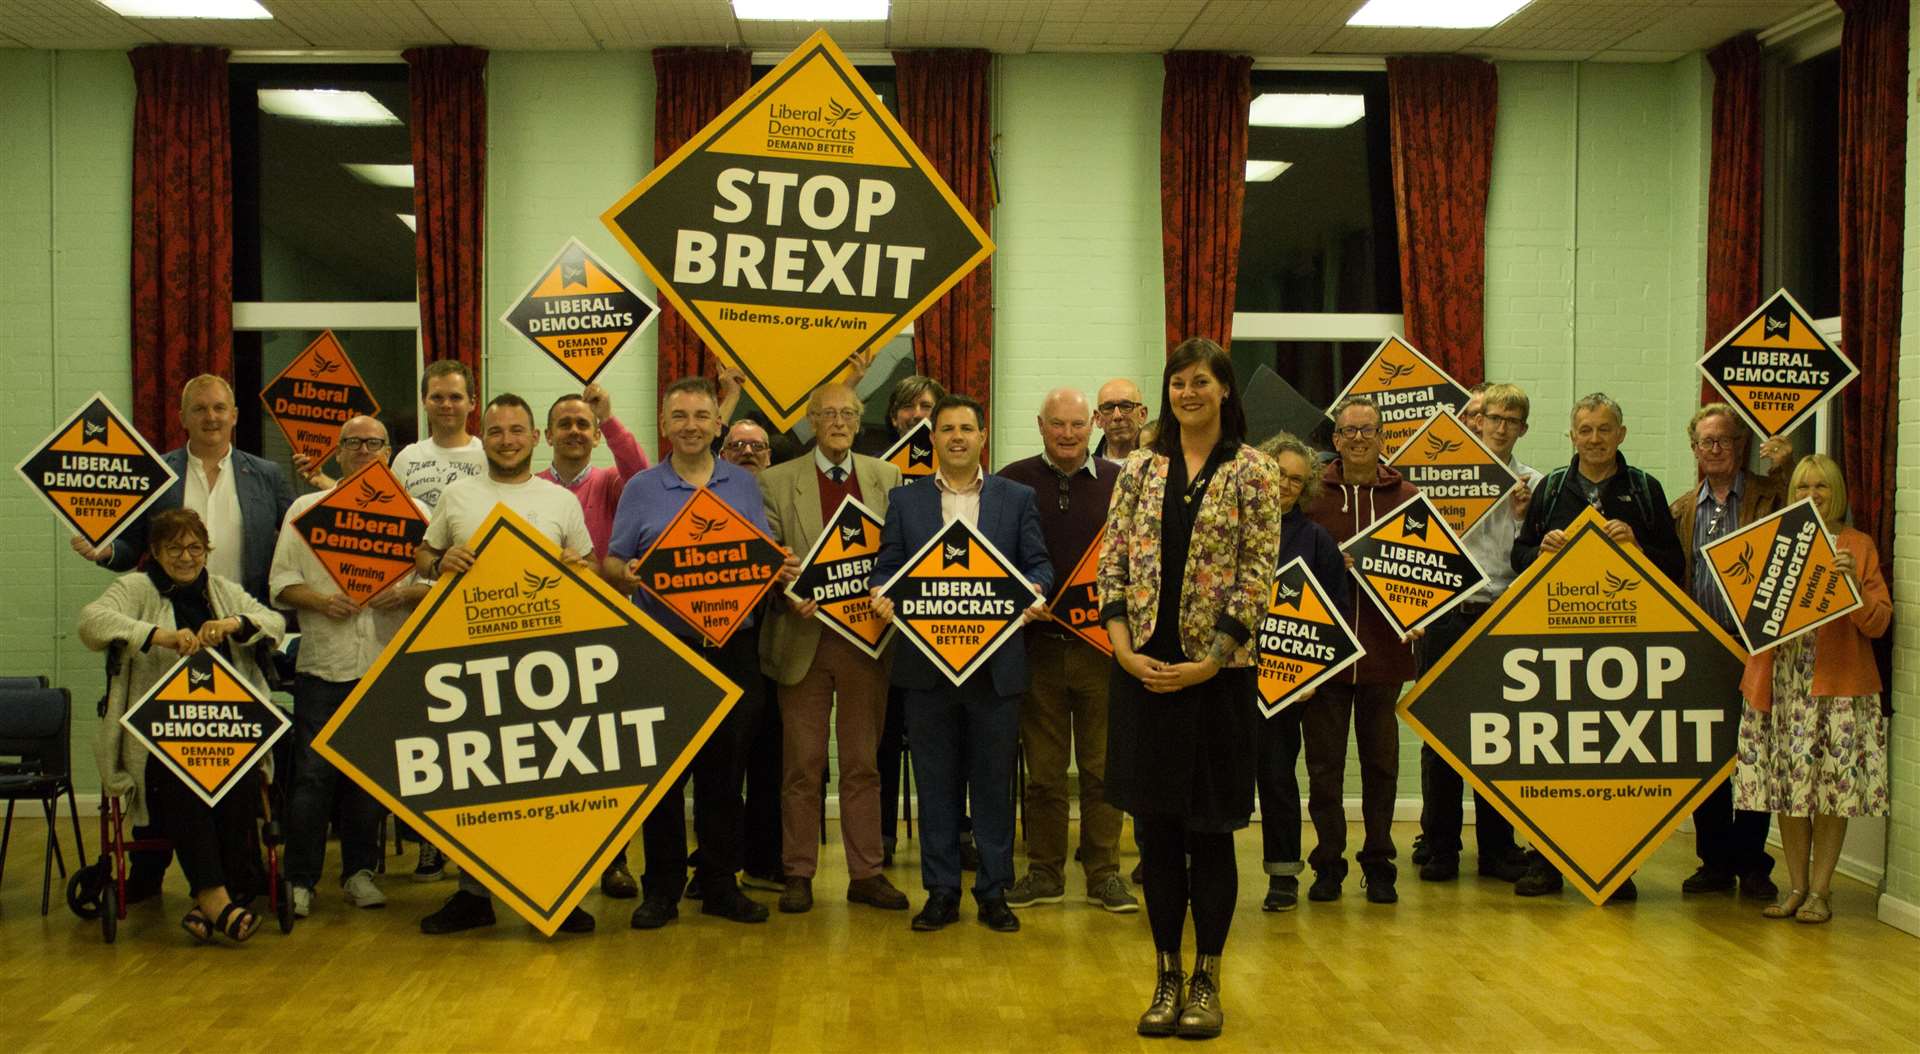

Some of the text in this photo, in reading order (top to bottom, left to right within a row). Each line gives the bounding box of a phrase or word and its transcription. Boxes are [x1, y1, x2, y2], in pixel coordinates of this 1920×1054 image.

[770, 103, 822, 122] Liberal
[768, 120, 856, 141] Democrats
[767, 139, 854, 154] DEMAND BETTER
[713, 168, 896, 233] STOP
[673, 229, 926, 300] BREXIT
[544, 297, 615, 315] LIBERAL
[528, 312, 633, 333] DEMOCRATS
[719, 307, 867, 331] libdems.org.uk/win
[557, 336, 608, 349] DEMAND
[563, 348, 605, 358] BETTER
[1742, 351, 1813, 367] LIBERAL
[1723, 367, 1830, 385] DEMOCRATS
[293, 381, 349, 404] Liberal
[1749, 390, 1800, 402] DEMAND
[1753, 401, 1795, 412] BETTER
[296, 429, 332, 447] Winning
[303, 444, 322, 458] Here
[61, 455, 133, 473] LIBERAL
[1409, 465, 1480, 481] Liberal
[43, 472, 150, 491] DEMOCRATS
[1416, 482, 1500, 497] mocrats
[70, 496, 122, 508] DEMAND
[75, 508, 116, 518] BETTER
[334, 511, 406, 537] Liberal
[310, 527, 417, 558] Democrat
[673, 542, 748, 568] Liberal
[1380, 544, 1448, 570] LIBERAL
[340, 562, 385, 582] Winning
[654, 563, 772, 590] Democrats
[826, 557, 879, 581] LIBER
[1361, 556, 1463, 588] DEMOCRATS
[1752, 534, 1792, 611] Liberal
[347, 579, 373, 593] Here
[1762, 520, 1816, 637] Democrats
[1799, 564, 1826, 608] Working
[463, 581, 519, 604] Liberal
[921, 581, 996, 597] LIBERAL
[1385, 583, 1434, 599] DEMAND
[1547, 580, 1600, 596] Liberal
[465, 598, 561, 620] Democrats
[690, 598, 739, 614] Winning
[902, 599, 1015, 615] DEMOCRATS
[1389, 592, 1429, 608] BETTER
[1547, 598, 1637, 612] Democrats
[1816, 596, 1830, 613] for
[468, 615, 562, 636] DEMAND BETTER
[703, 615, 730, 628] Here
[931, 624, 985, 634] DEMAND
[1548, 615, 1637, 625] DEMAND BETTER
[936, 635, 980, 645] BETTER
[1259, 634, 1336, 662] MOCRATS
[1259, 658, 1304, 674] EMAND
[1502, 645, 1686, 702] STOP
[424, 644, 619, 723] STOP
[168, 704, 243, 720] LIBERAL
[151, 722, 263, 738] DEMOCRATS
[1470, 709, 1725, 765] BREXIT
[181, 746, 235, 756] DEMAND
[395, 706, 666, 797] BREXIT
[187, 757, 230, 766] BETTER
[1519, 785, 1672, 801] libdems.org.uk/win
[455, 795, 618, 827] libdems.org.uk/win
